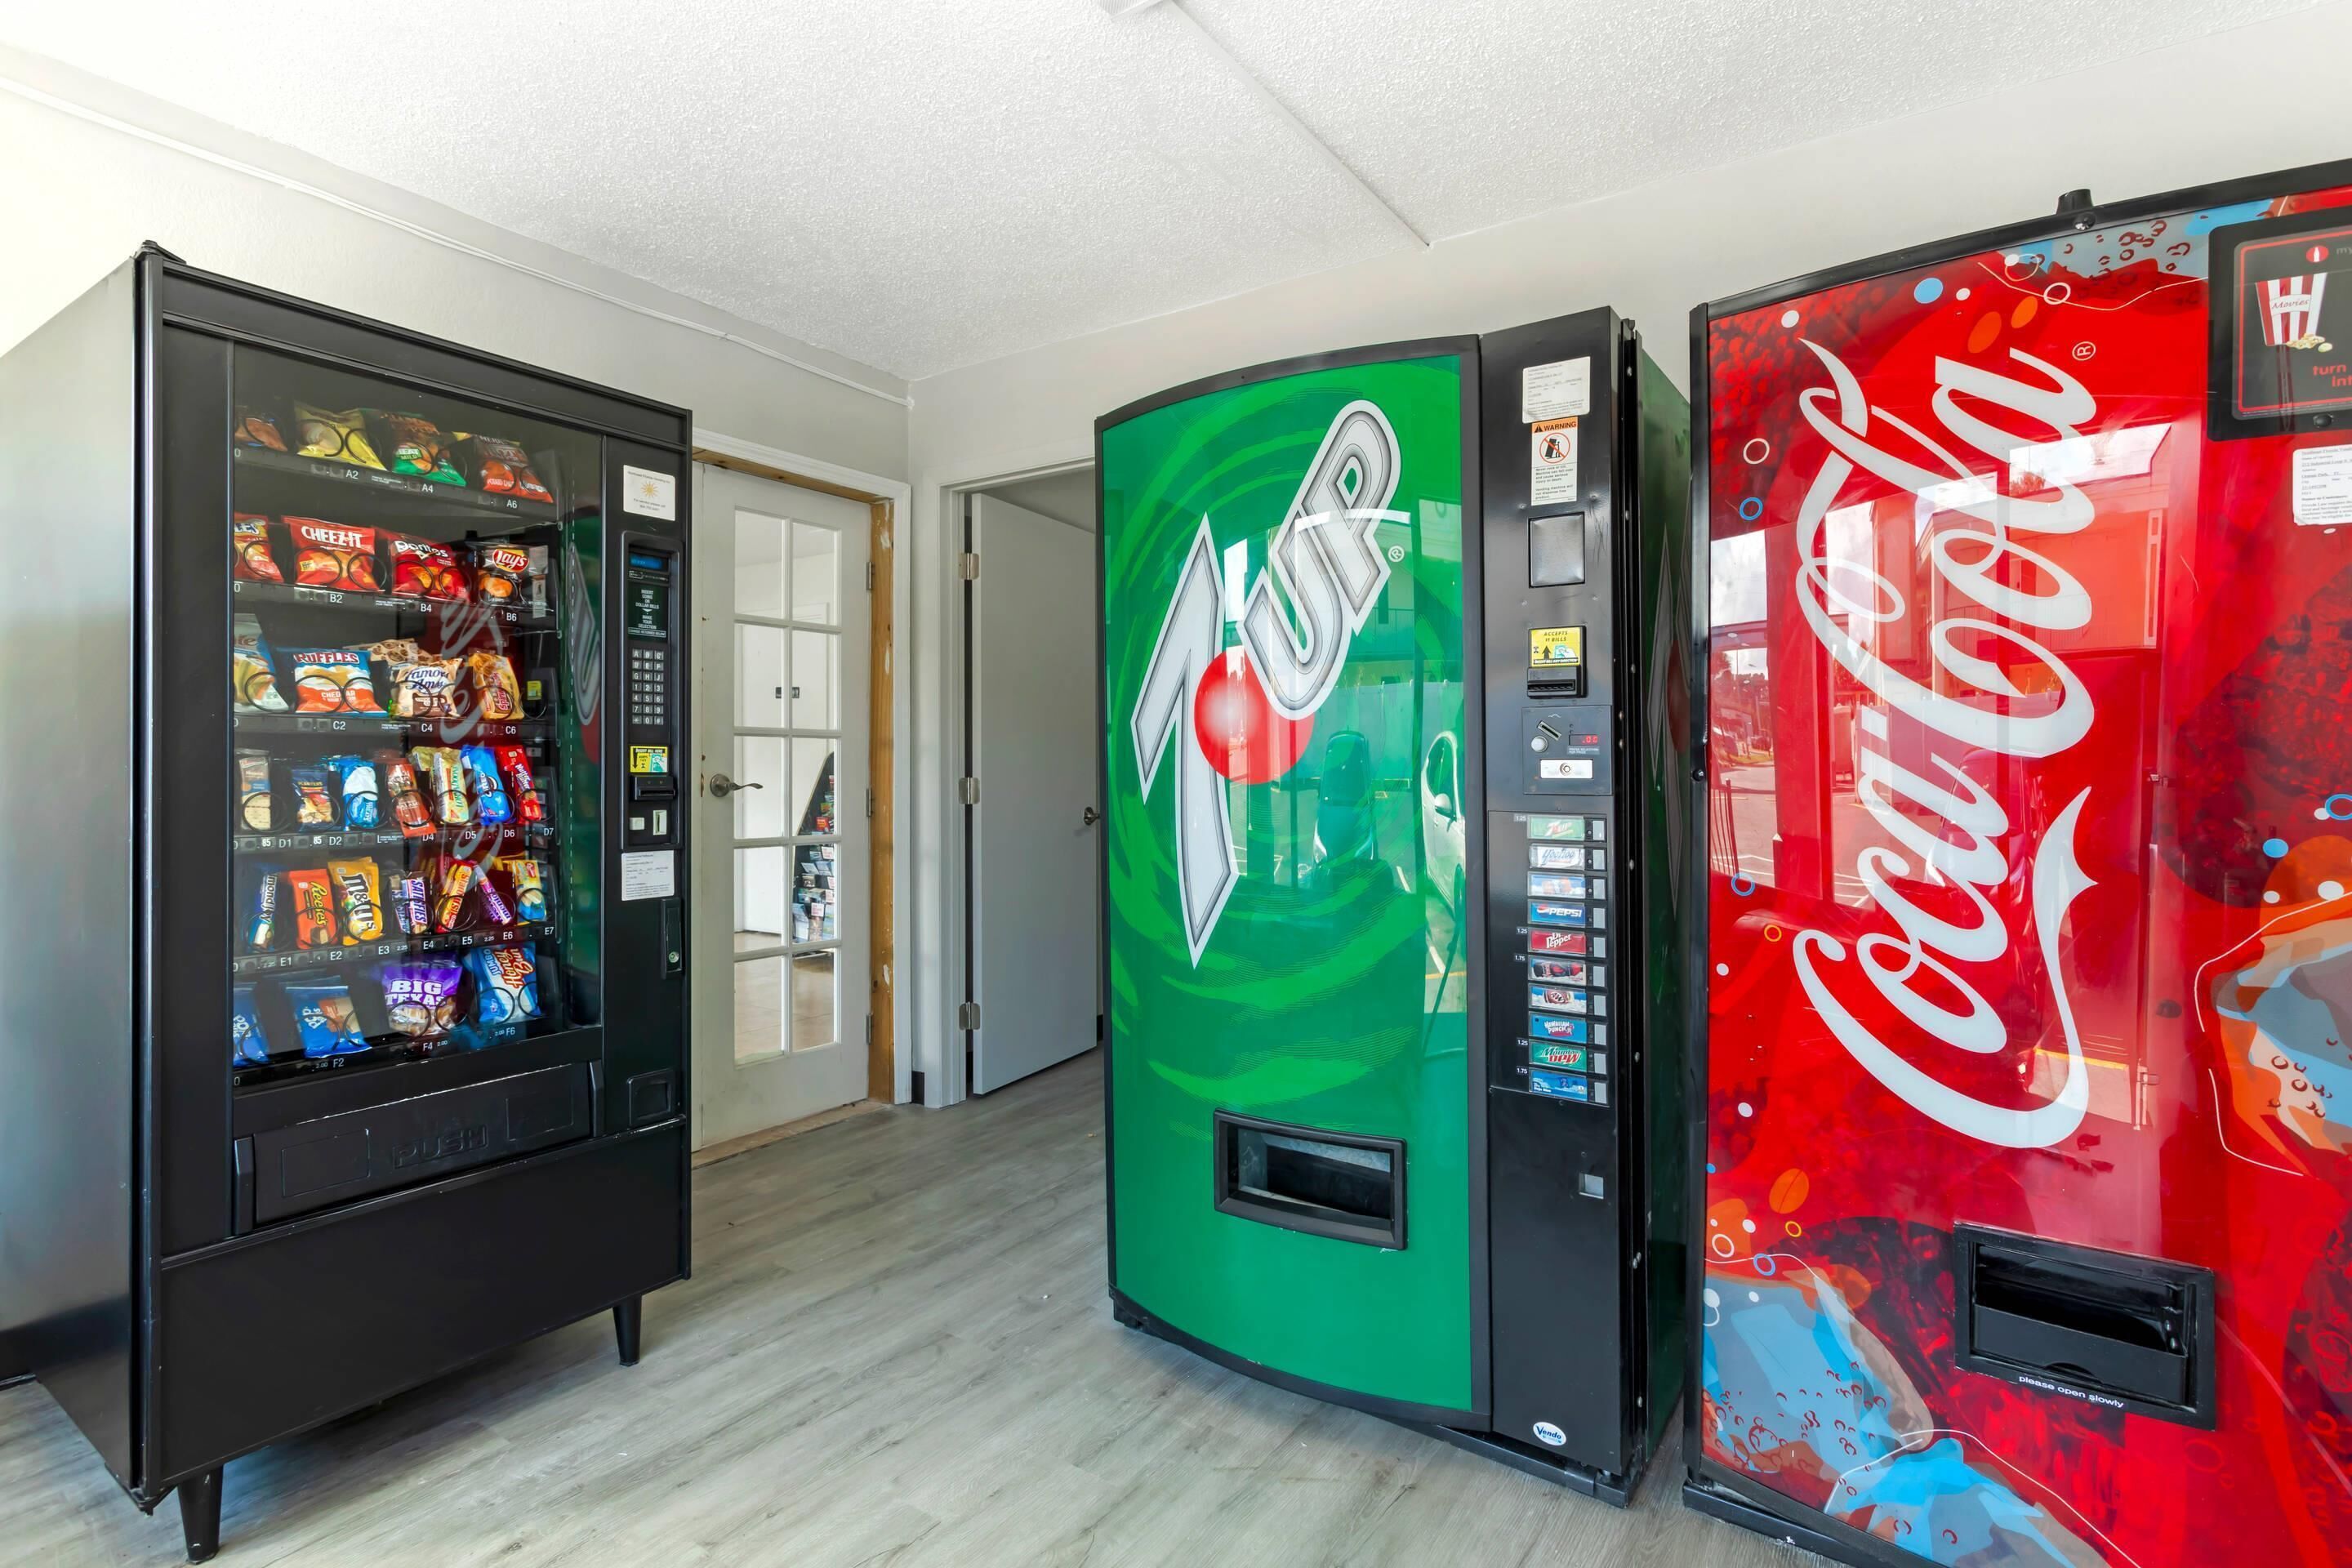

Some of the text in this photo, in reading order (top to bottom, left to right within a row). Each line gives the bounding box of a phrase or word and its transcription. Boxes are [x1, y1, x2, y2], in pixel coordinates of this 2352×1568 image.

[2270, 298, 2310, 310] Movies
[2312, 364, 2347, 376] turn
[1544, 421, 1577, 431] WARNING
[345, 470, 359, 479] A2
[421, 483, 434, 493] A4
[506, 499, 518, 509] A6
[301, 526, 363, 549] CHEEZ-IT
[394, 540, 449, 558] Doritos
[330, 594, 343, 604] B2
[421, 603, 432, 612] B4
[506, 612, 517, 621] B6
[293, 652, 360, 665] RUFFLES
[321, 689, 356, 698] CHEDAR
[333, 721, 346, 730] C2
[421, 724, 433, 733] C4
[506, 725, 517, 734] C6
[1793, 336, 2099, 1149] Coca-Cola
[465, 831, 477, 840] D5
[504, 830, 515, 839] D6
[544, 828, 555, 836] D7
[278, 839, 292, 848] D1
[329, 836, 342, 846] D2
[422, 833, 434, 842] D4
[410, 880, 426, 924] SATISFIES
[1549, 907, 1583, 918] PEPSI
[503, 932, 514, 940] E6
[545, 927, 555, 936] E7
[1552, 932, 1561, 940] Dr
[423, 941, 434, 950] E4
[462, 937, 473, 946] E5
[1546, 933, 1572, 949] Pepper
[378, 946, 390, 955] E3
[330, 951, 342, 961] E2
[280, 957, 292, 967] E1
[483, 948, 503, 976] JUMBO
[510, 948, 533, 975] Bun
[495, 949, 524, 988] Honey
[390, 979, 443, 995] BIG
[385, 992, 448, 1006] TEXAS
[506, 1027, 515, 1036] F6
[423, 1043, 433, 1052] F4
[332, 1058, 345, 1067] F2
[392, 1125, 488, 1169] PUSH
[2019, 1375, 2124, 1409] please open slowly
[1536, 1425, 1562, 1440] Vendo
